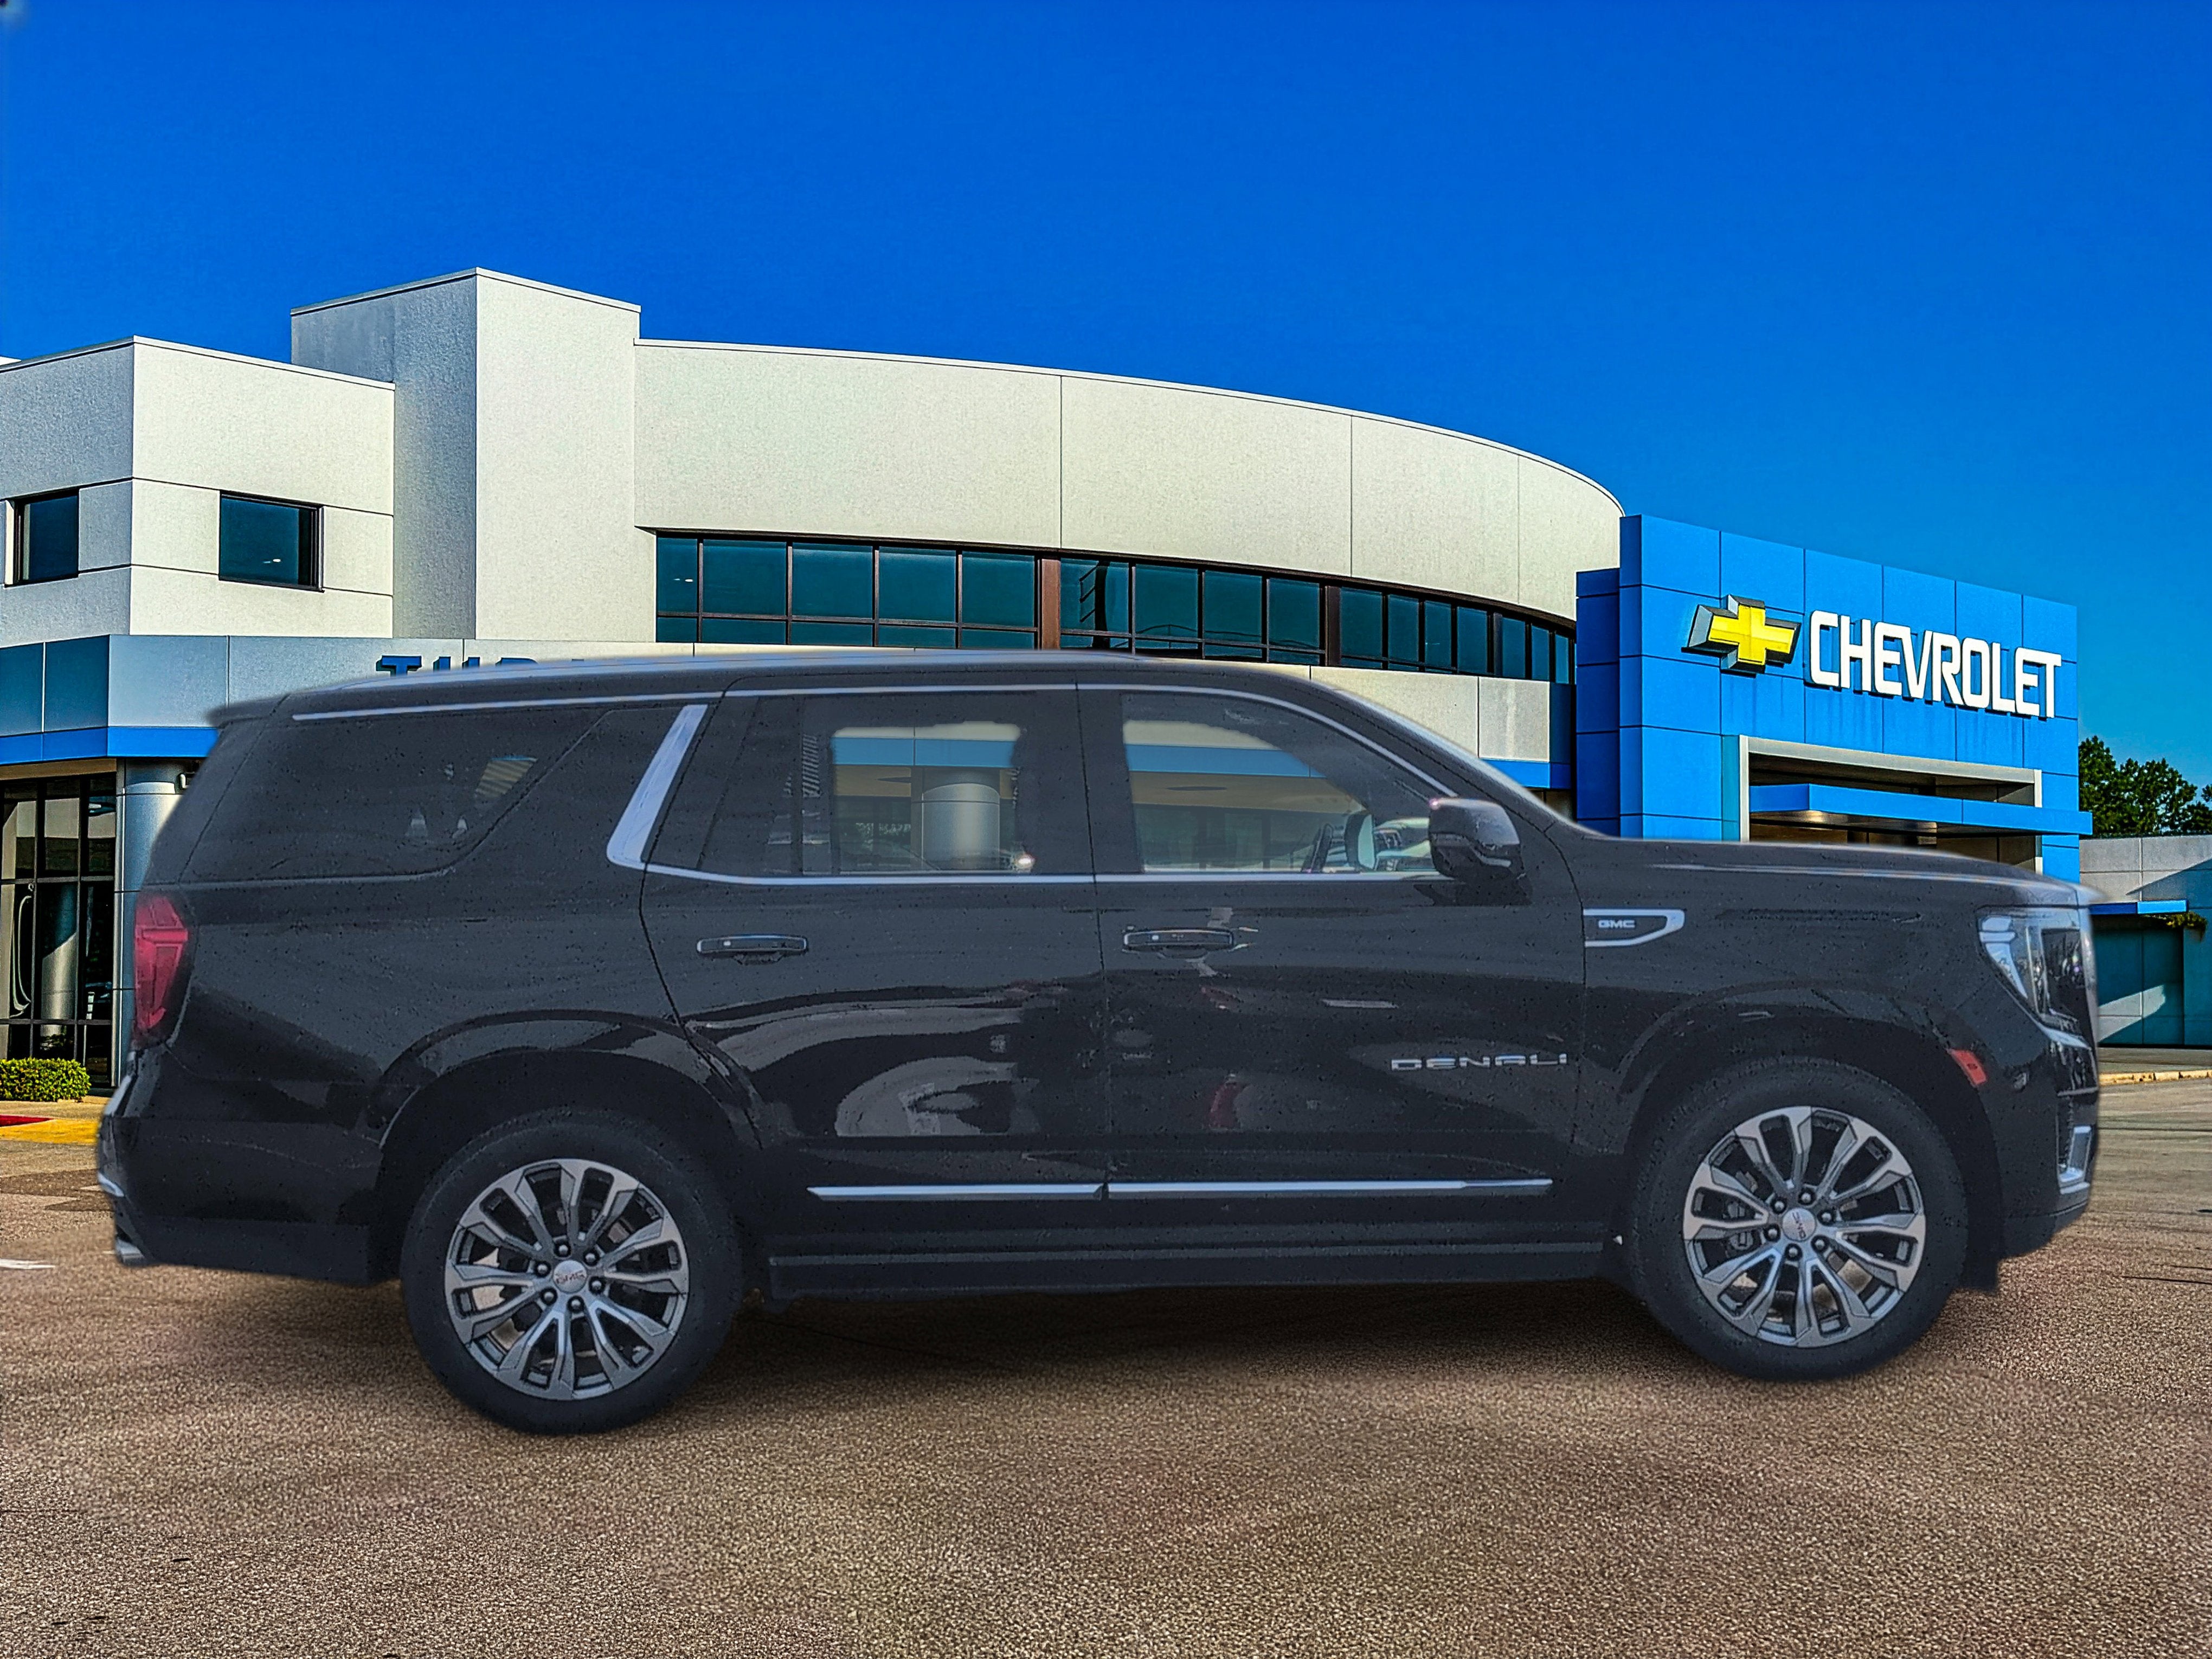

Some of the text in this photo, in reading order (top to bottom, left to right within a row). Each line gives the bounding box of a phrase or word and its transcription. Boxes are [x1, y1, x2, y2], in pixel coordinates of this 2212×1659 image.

[1809, 609, 2062, 718] CHEVROLET
[1598, 919, 1636, 928] GMC
[1391, 1053, 1568, 1072] DENALI
